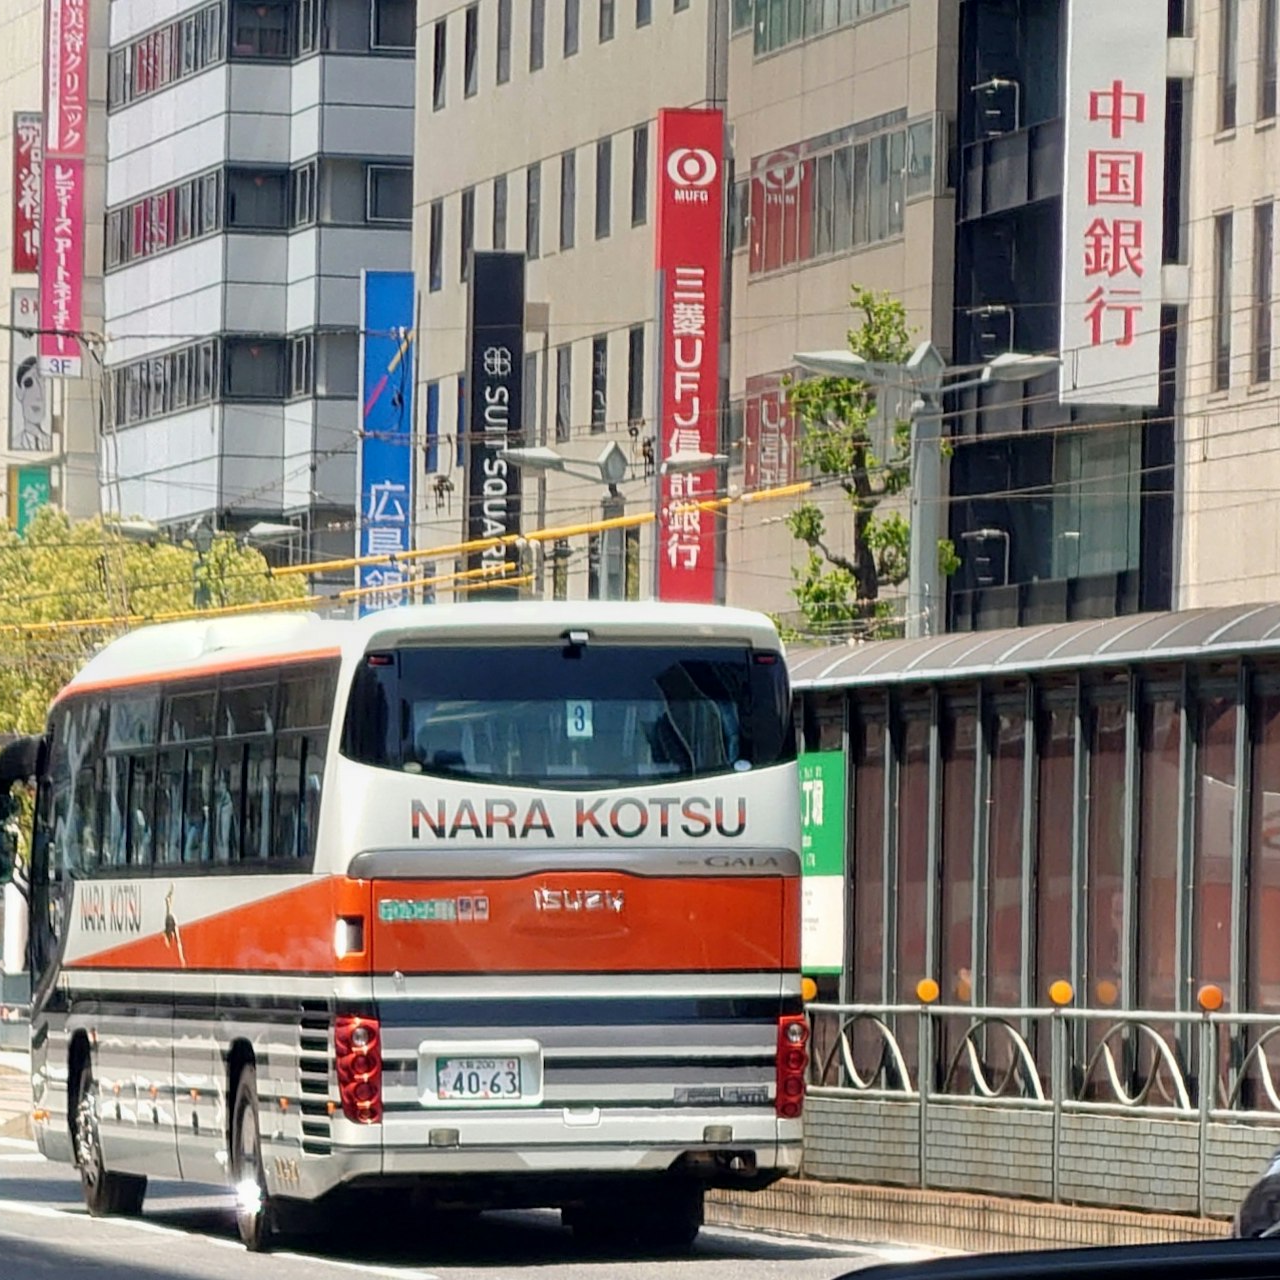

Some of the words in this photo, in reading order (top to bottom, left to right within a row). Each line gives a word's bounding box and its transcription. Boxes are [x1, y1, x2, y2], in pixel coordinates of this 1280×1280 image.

[62, 0, 84, 149] 美容クリニック
[674, 189, 709, 202] MUFG
[1084, 80, 1145, 346] 中国銀行
[48, 358, 72, 375] 3F
[484, 385, 509, 450] SUIT
[482, 457, 508, 578] SQUARE
[573, 706, 586, 732] 3
[411, 798, 555, 839] NARA
[576, 797, 747, 839] KOTSU
[704, 856, 779, 869] GALA
[533, 888, 625, 913] ISUZU
[452, 1071, 517, 1095] 40-63
